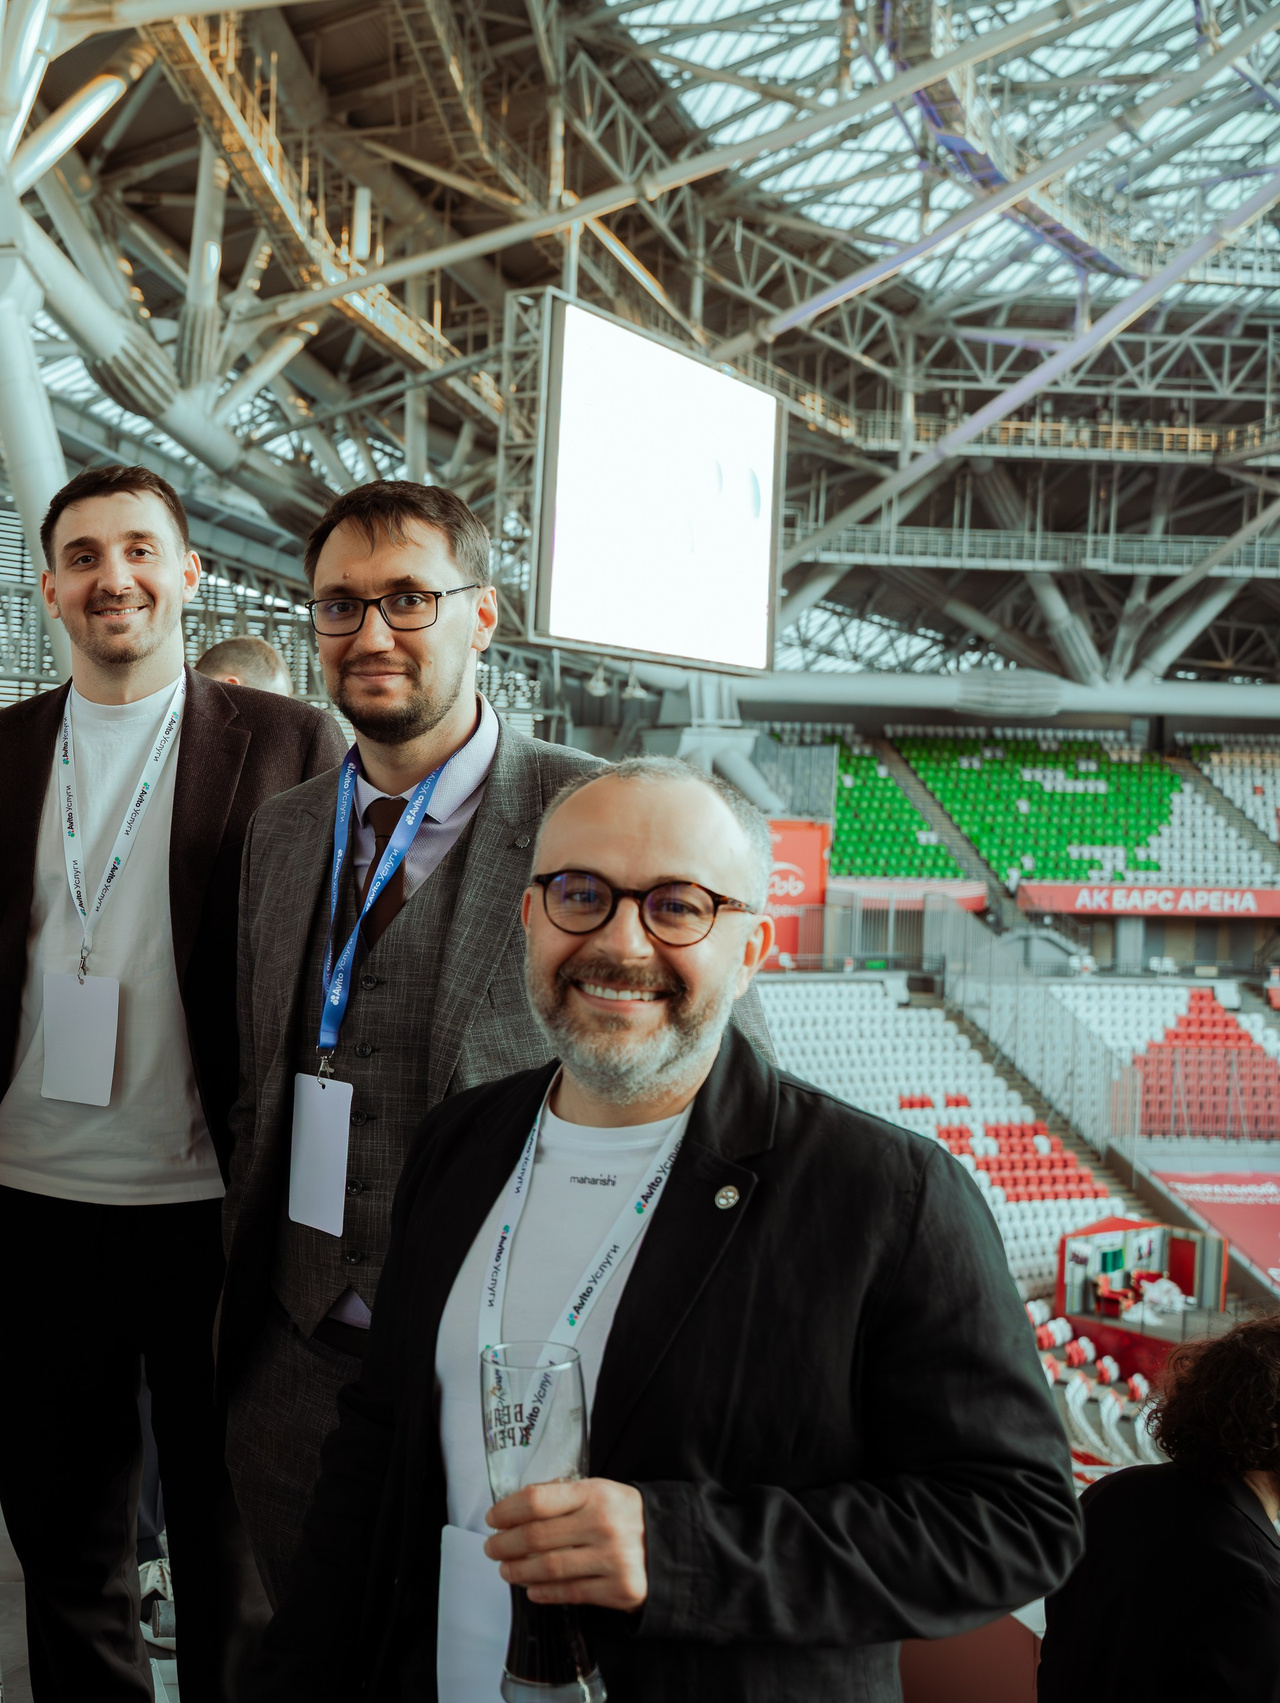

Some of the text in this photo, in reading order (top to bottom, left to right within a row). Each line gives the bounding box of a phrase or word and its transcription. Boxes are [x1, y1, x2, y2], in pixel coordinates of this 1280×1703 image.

[153, 717, 176, 762] Avito Услуги
[124, 789, 148, 836] Avito Услуги
[339, 769, 353, 823] Avito Услуги
[409, 795, 425, 817] Avito
[72, 860, 84, 909] Avito Услуги
[95, 864, 119, 912] Avito Услуги
[369, 848, 399, 904] Avito Услуги
[1075, 888, 1257, 913] АК БАРС АРЕНА
[332, 938, 354, 996] Avito Услуги
[570, 1174, 617, 1187] maharishi
[640, 1176, 663, 1204] Avito
[487, 1263, 501, 1307] Услуги
[573, 1244, 620, 1315] Avito Услуги
